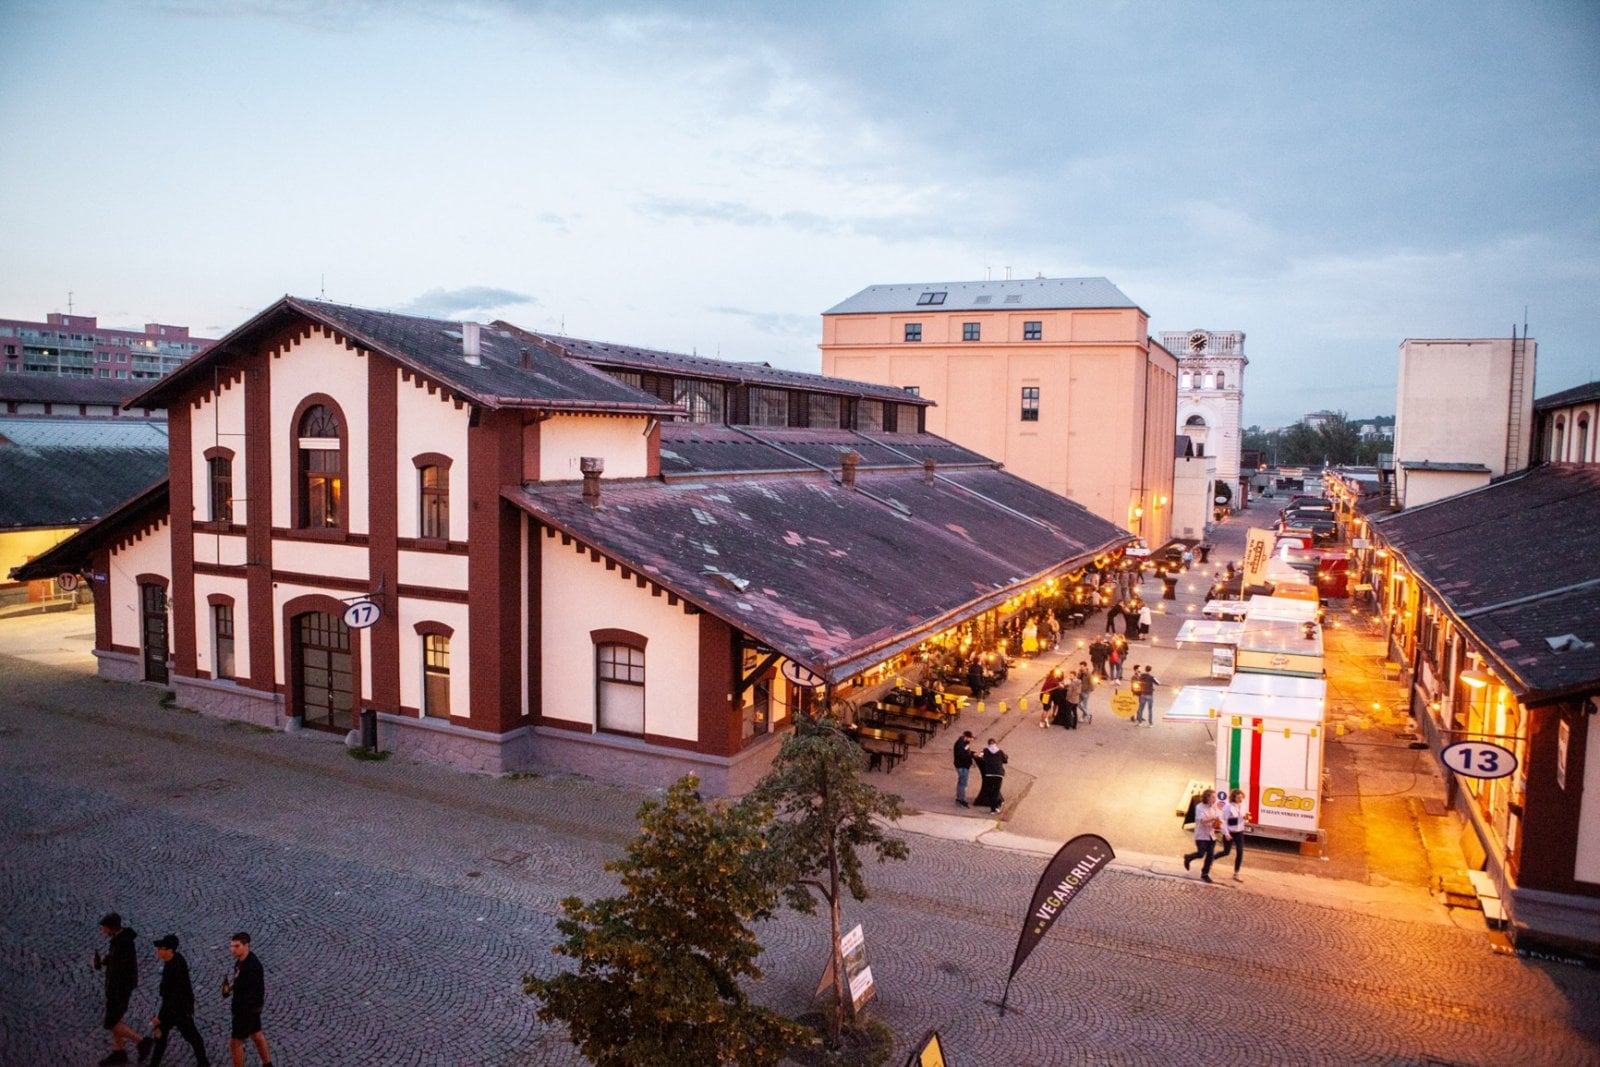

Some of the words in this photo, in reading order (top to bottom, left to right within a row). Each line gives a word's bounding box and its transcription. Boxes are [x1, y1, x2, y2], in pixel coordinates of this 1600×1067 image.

[61, 575, 73, 587] 17
[352, 606, 372, 624] 17
[1458, 747, 1499, 772] 13
[1262, 787, 1315, 811] Ciao
